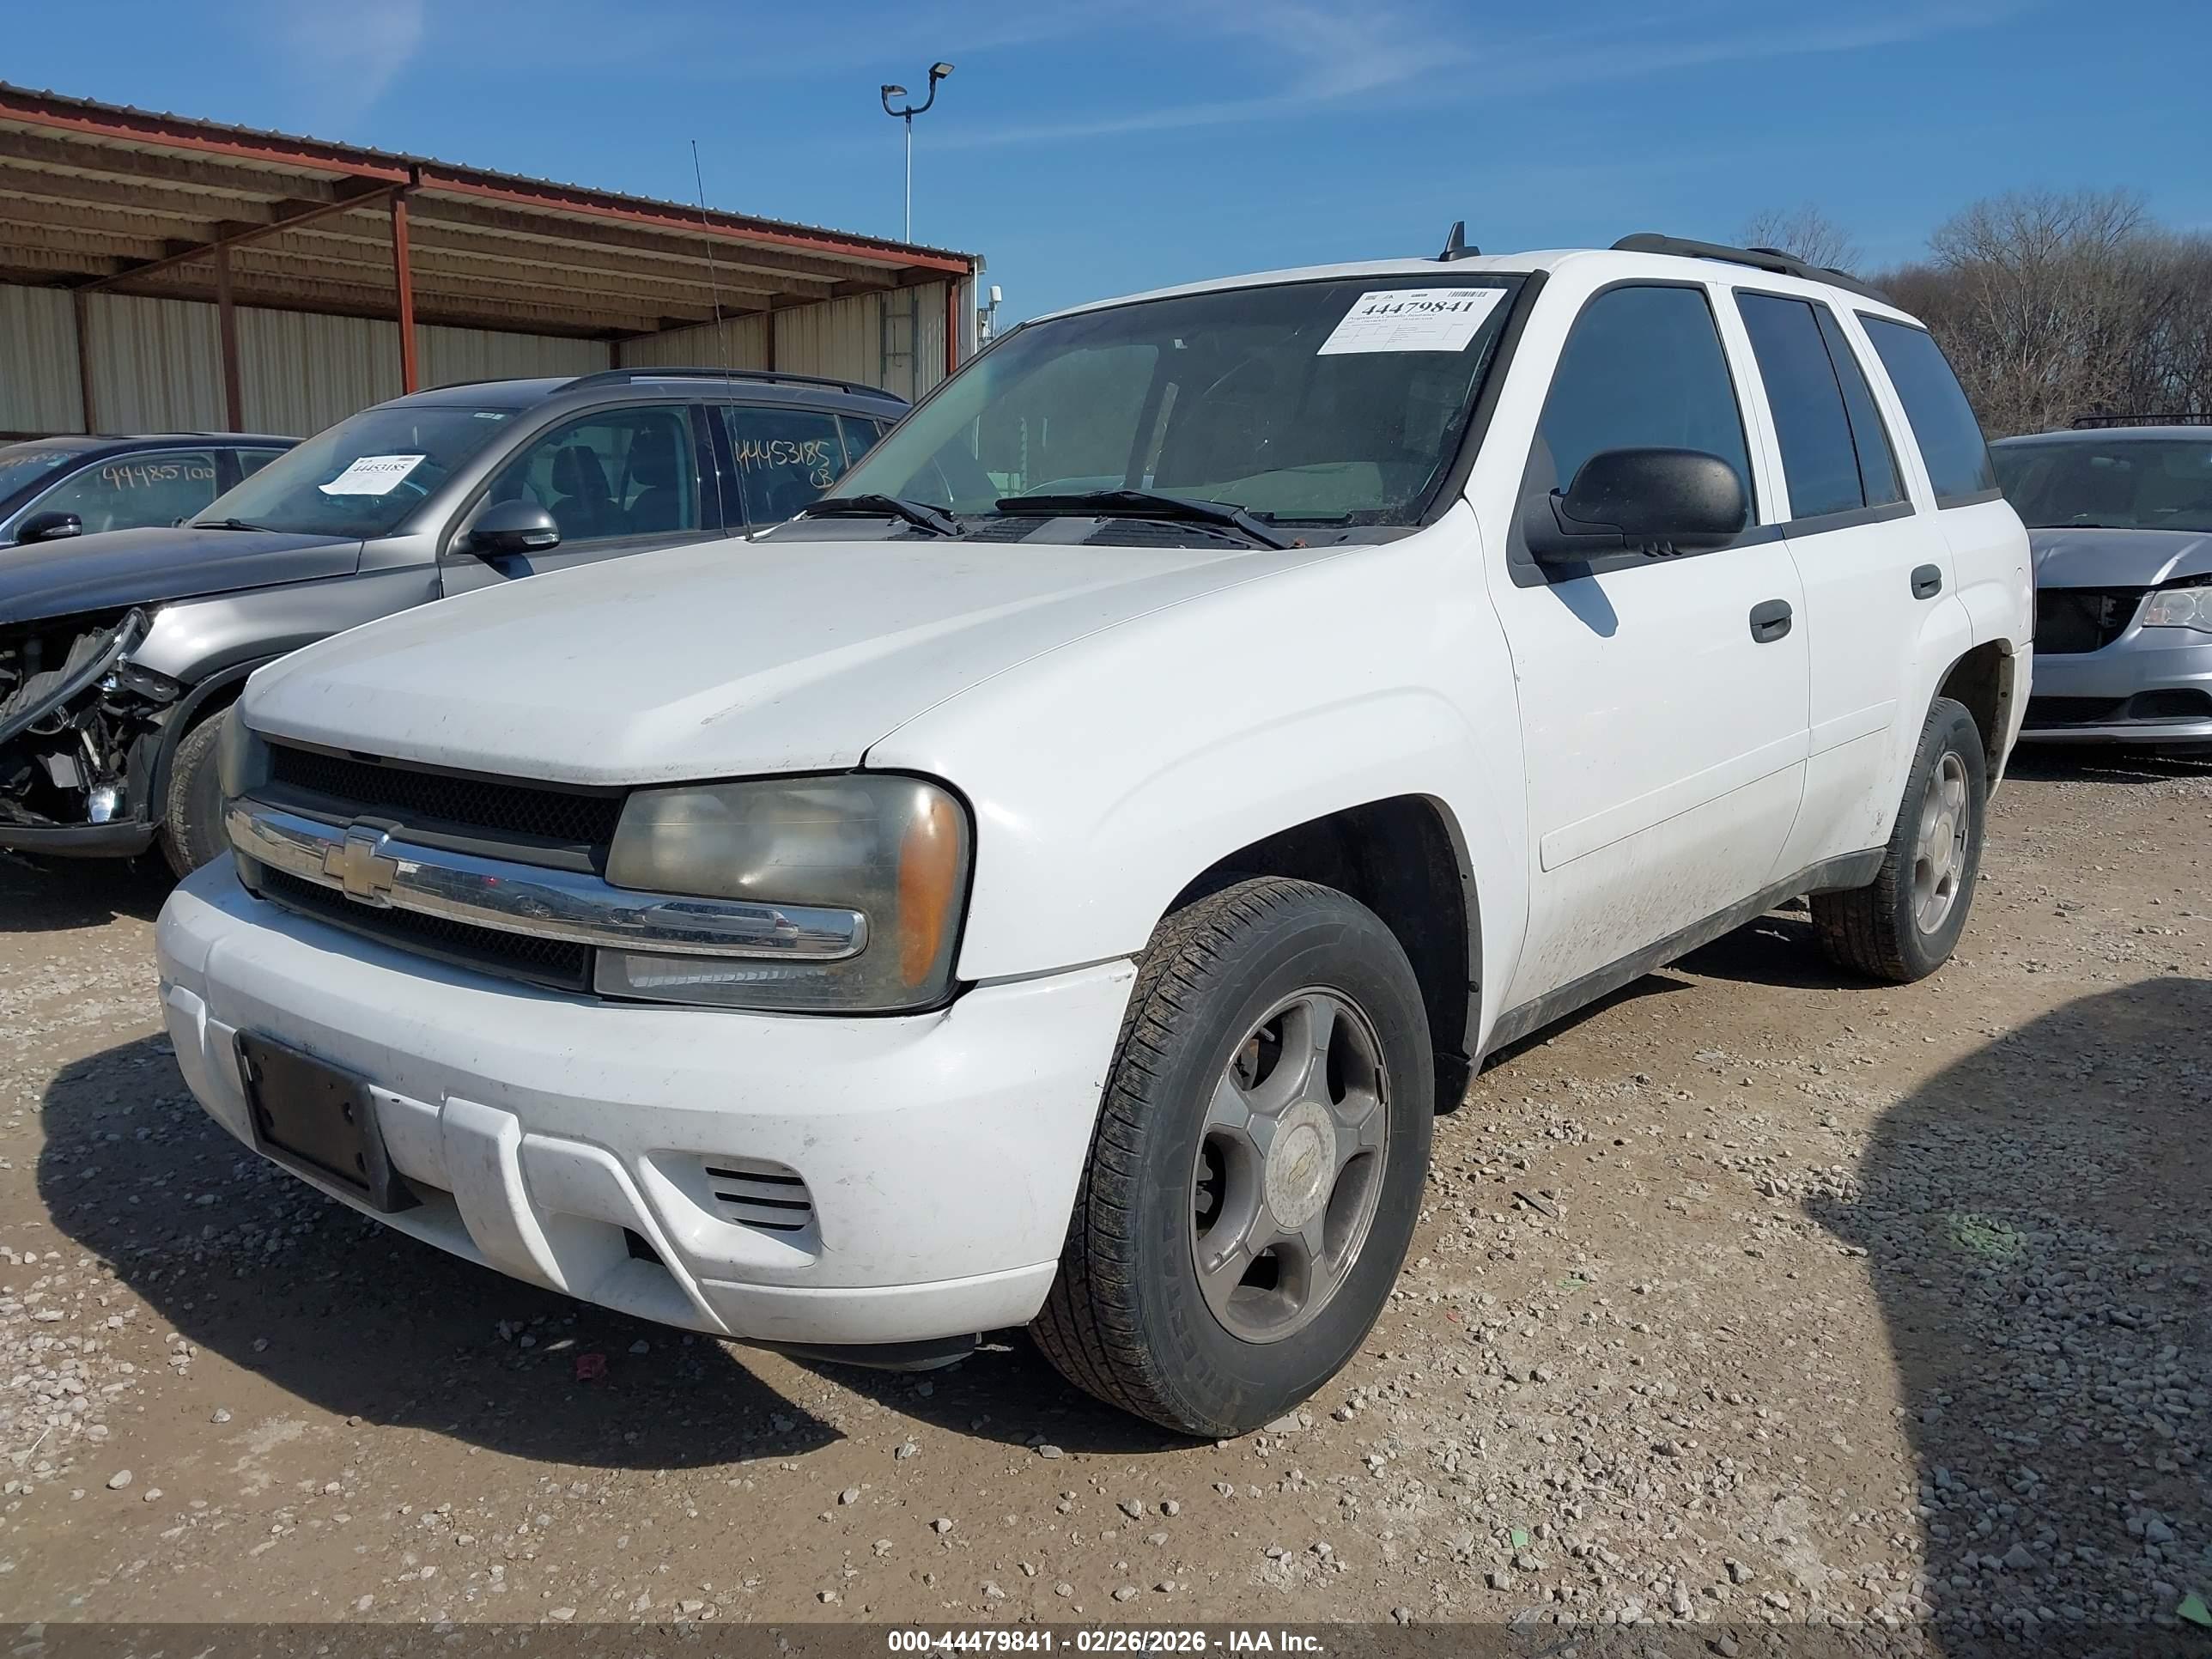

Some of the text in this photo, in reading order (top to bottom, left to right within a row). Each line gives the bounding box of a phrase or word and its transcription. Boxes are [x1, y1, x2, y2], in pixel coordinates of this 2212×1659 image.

[1361, 301, 1475, 316] 44479841
[734, 439, 831, 474] 44453185
[102, 465, 215, 491] 44485100
